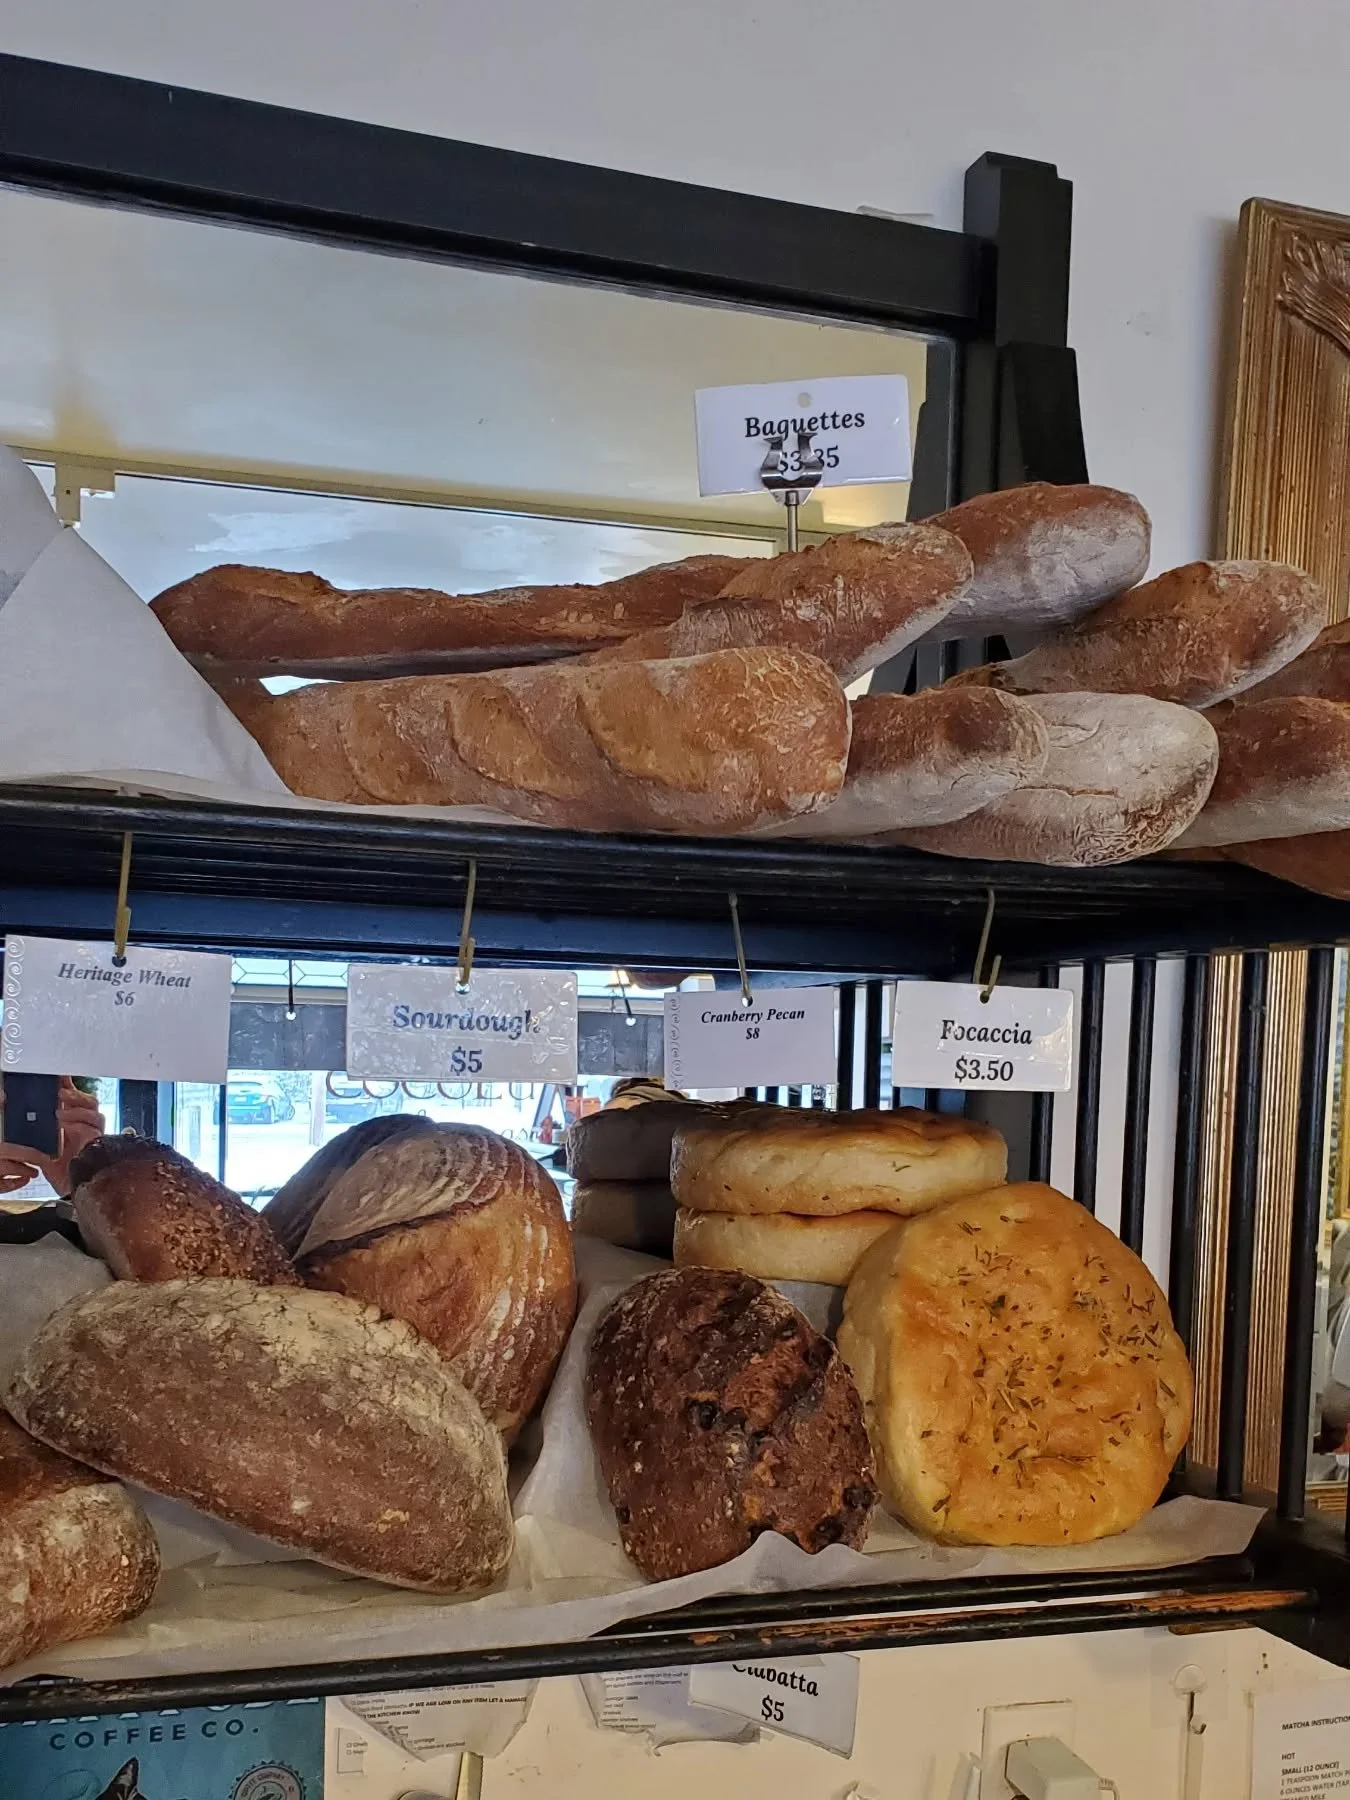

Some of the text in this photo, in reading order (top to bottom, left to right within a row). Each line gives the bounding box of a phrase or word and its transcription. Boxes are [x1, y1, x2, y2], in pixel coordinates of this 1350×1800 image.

[744, 411, 865, 440] Baguettes
[58, 963, 191, 988] Heritage Wheat
[114, 990, 136, 1006] $6
[393, 1005, 541, 1040] Sourdough
[701, 1008, 805, 1025] Cranberry Pecan
[745, 1027, 760, 1040] $8
[940, 1019, 1033, 1045] Focaccia
[450, 1046, 483, 1076] $5
[954, 1055, 1014, 1083] $3.50
[761, 1695, 785, 1721] $5
[50, 1718, 259, 1750] COFFEE CO.
[1282, 1721, 1310, 1730] MATCHA
[1282, 1767, 1302, 1776] SMALL
